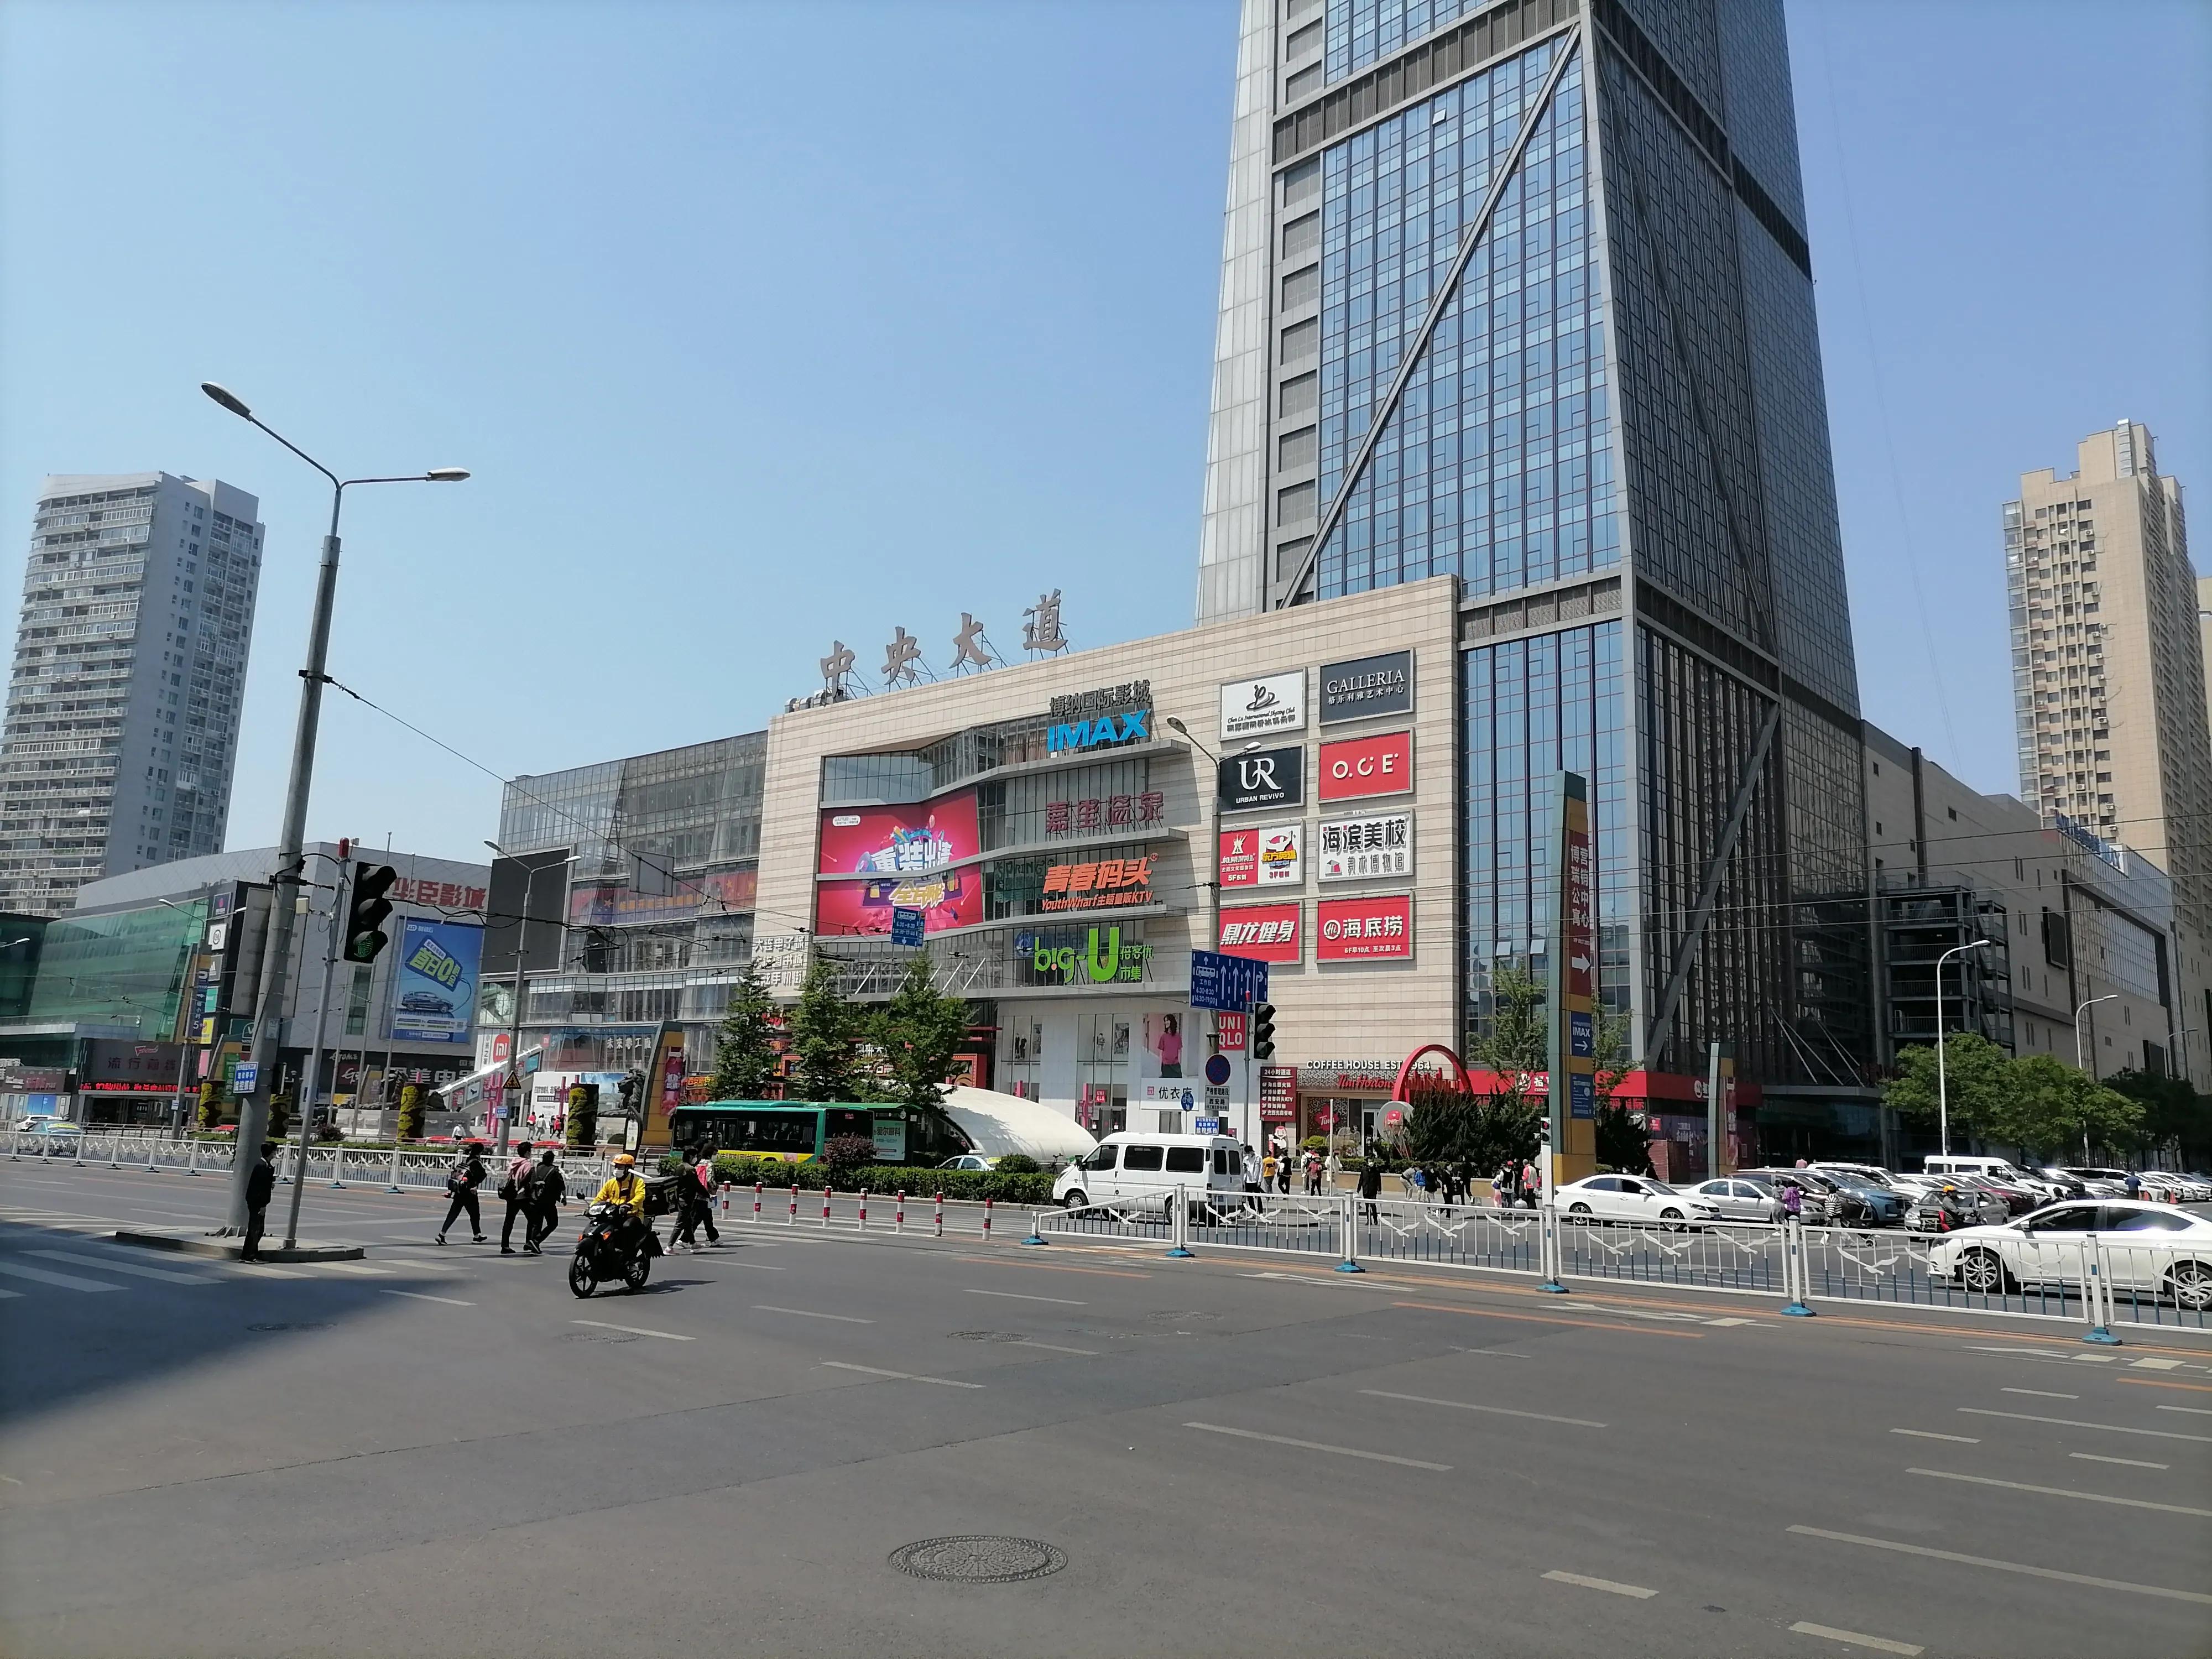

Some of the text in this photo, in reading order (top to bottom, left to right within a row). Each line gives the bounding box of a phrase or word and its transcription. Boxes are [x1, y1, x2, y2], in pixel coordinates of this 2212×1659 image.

[821, 588, 1068, 698] 中央大道
[1327, 669, 1405, 693] GALLERIA
[1050, 679, 1152, 717] 博纳国际影城
[1328, 685, 1404, 705] 格乐利雅艺术中心
[1047, 708, 1150, 752] IMAX
[1236, 792, 1285, 804] URBAN REVIVO
[1323, 818, 1405, 852] 海滨美校
[1348, 852, 1404, 874] 美术博物馆
[1043, 857, 1153, 894] 青春码头
[1571, 844, 1580, 926] 博瑞公寓
[1580, 847, 1589, 928] 营销中心
[393, 877, 487, 910] 华臣影城
[1220, 920, 1296, 946] 鼎龙健身
[1343, 915, 1403, 939] 海底捞
[1121, 966, 1142, 982] 市集
[1219, 1016, 1240, 1030] UNI
[1573, 1026, 1590, 1037] IMAX
[1219, 1032, 1243, 1048] QLO
[107, 1057, 178, 1071] 流行前线
[1306, 1060, 1344, 1070] COFFEE
[1346, 1060, 1380, 1070] HOUSE
[1338, 1074, 1354, 1088] Tim
